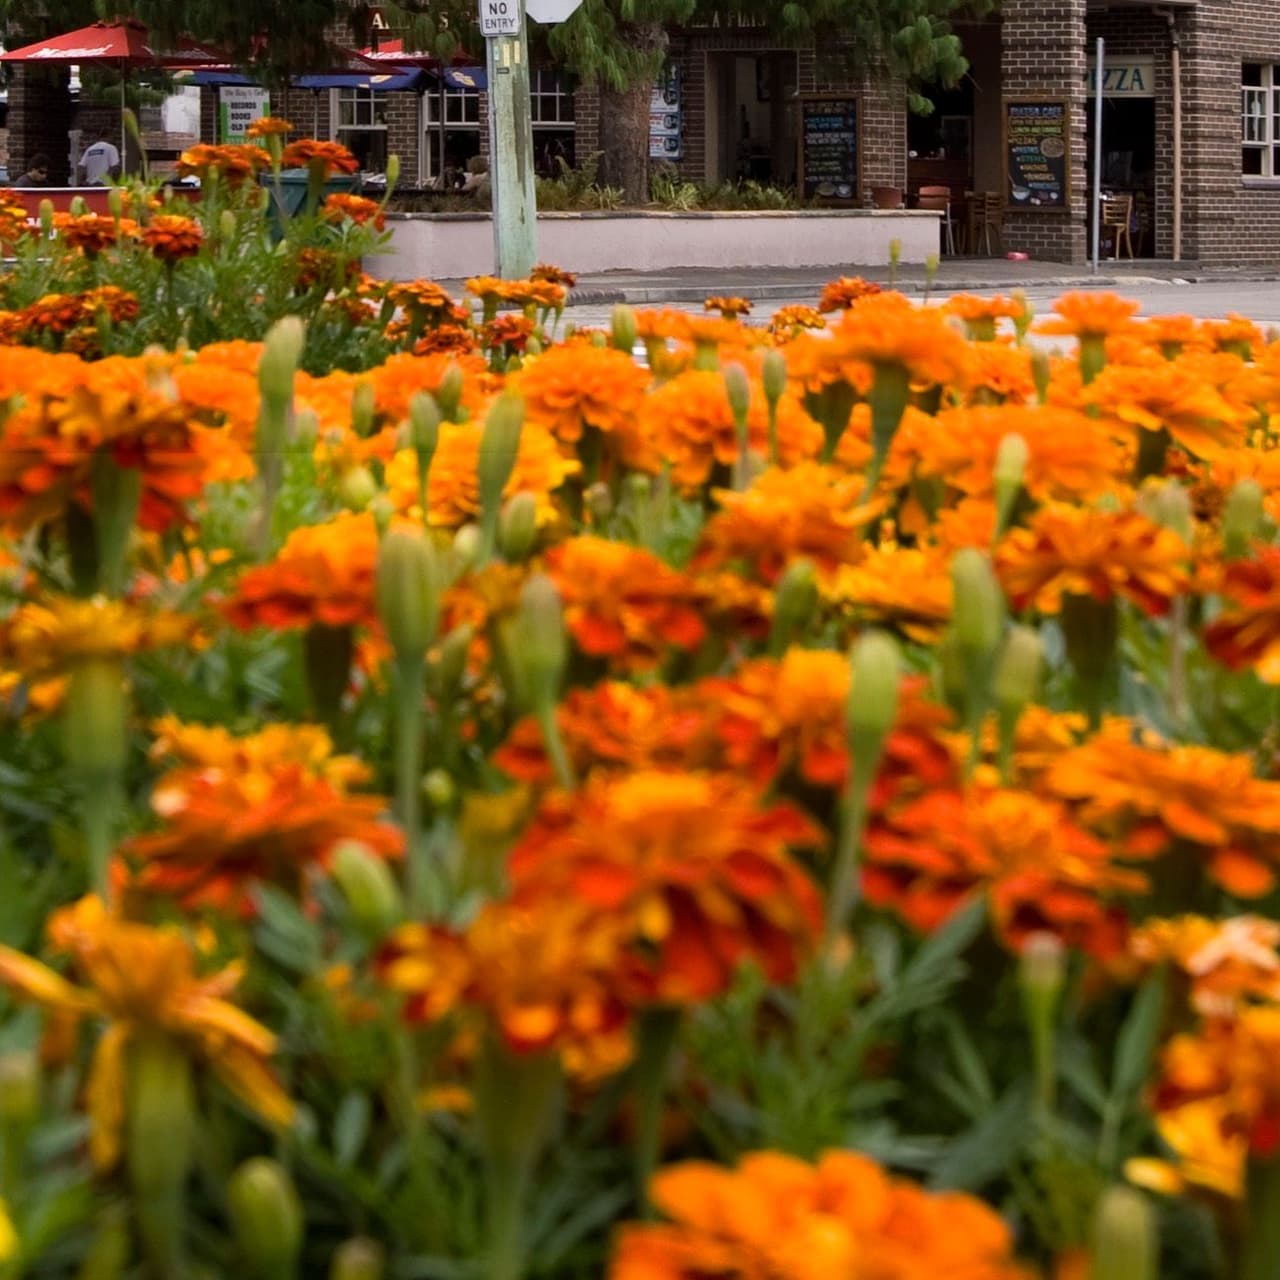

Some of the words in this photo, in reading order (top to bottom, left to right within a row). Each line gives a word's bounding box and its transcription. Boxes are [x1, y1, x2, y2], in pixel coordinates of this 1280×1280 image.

[489, 2, 507, 15] NO
[485, 18, 515, 29] ENTRY
[1088, 67, 1145, 91] IZZA
